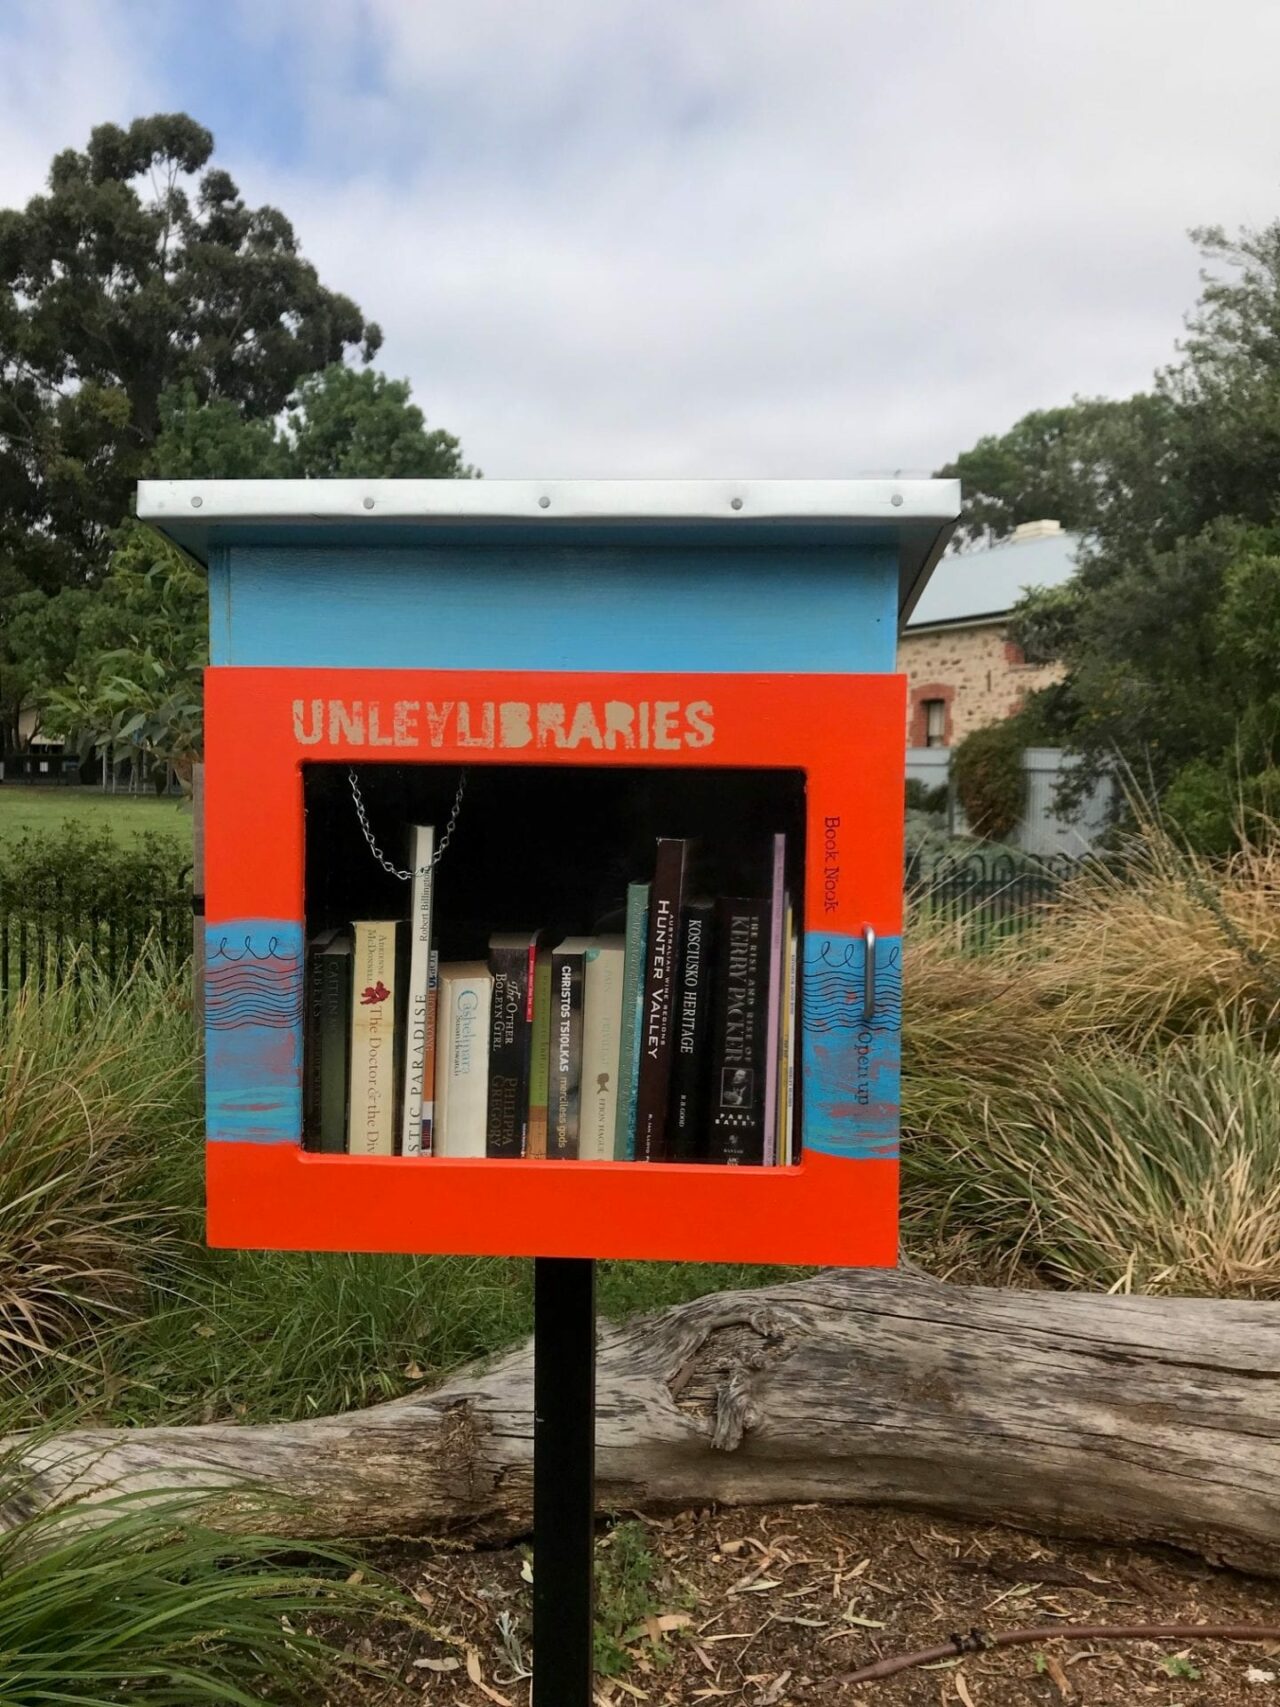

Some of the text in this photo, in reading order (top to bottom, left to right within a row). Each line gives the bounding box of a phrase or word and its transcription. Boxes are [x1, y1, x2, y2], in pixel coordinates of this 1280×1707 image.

[824, 816, 841, 912] Book Nook
[419, 913, 430, 942] Robert
[312, 951, 323, 1017] EMBERS
[327, 961, 339, 1015] CAITLIN
[492, 972, 506, 1052] BOLEYN GIRL
[504, 980, 521, 1045] The OTHER
[647, 899, 670, 1060] HUNTER VALLEY
[660, 914, 674, 1046] AUSTRALIAN WINE REGIONS
[680, 919, 702, 1053] KOSCIUSKO HERITAGE
[725, 915, 750, 1062] KERRY PACKER
[744, 915, 759, 1063] THE RISE AND RISE OF
[369, 1006, 383, 1034] The
[424, 993, 435, 1052] HONG KONG
[454, 1015, 462, 1039] Susan
[457, 990, 479, 1075] Cashelmara
[559, 965, 572, 1072] CHRISTOS TSIOLKAS
[367, 1087, 382, 1104] &
[368, 1037, 382, 1086] Doctor
[408, 993, 427, 1152] STIC PARADISE
[854, 1032, 873, 1106] Open up
[367, 1104, 380, 1128] the
[489, 1074, 504, 1148] GREGORY
[502, 1077, 518, 1146] PHILIPPA
[556, 1076, 570, 1148] merciless gods
[714, 1118, 756, 1127] BARRY
[719, 1112, 751, 1121] PAUL
